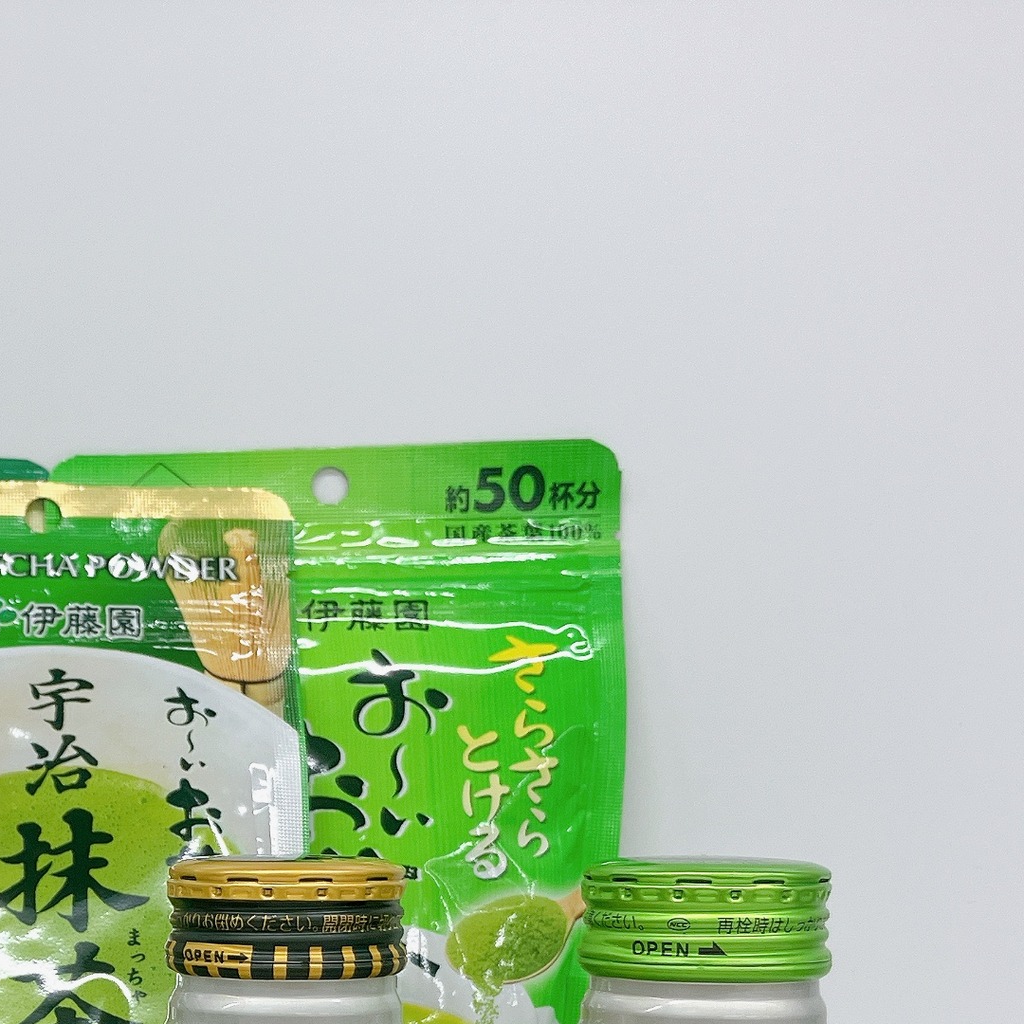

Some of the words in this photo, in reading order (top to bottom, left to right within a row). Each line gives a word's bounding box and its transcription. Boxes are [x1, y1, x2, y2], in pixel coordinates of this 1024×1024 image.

[445, 465, 601, 513] 約50杯分
[85, 552, 239, 582] POWDER
[22, 603, 144, 639] 伊藤園
[300, 598, 430, 632] 伊藤園
[488, 634, 559, 858] さらさら
[457, 724, 510, 880] とける
[126, 928, 149, 1003] まっちゃ
[184, 947, 225, 964] OPEN
[631, 940, 690, 958] OPEN
